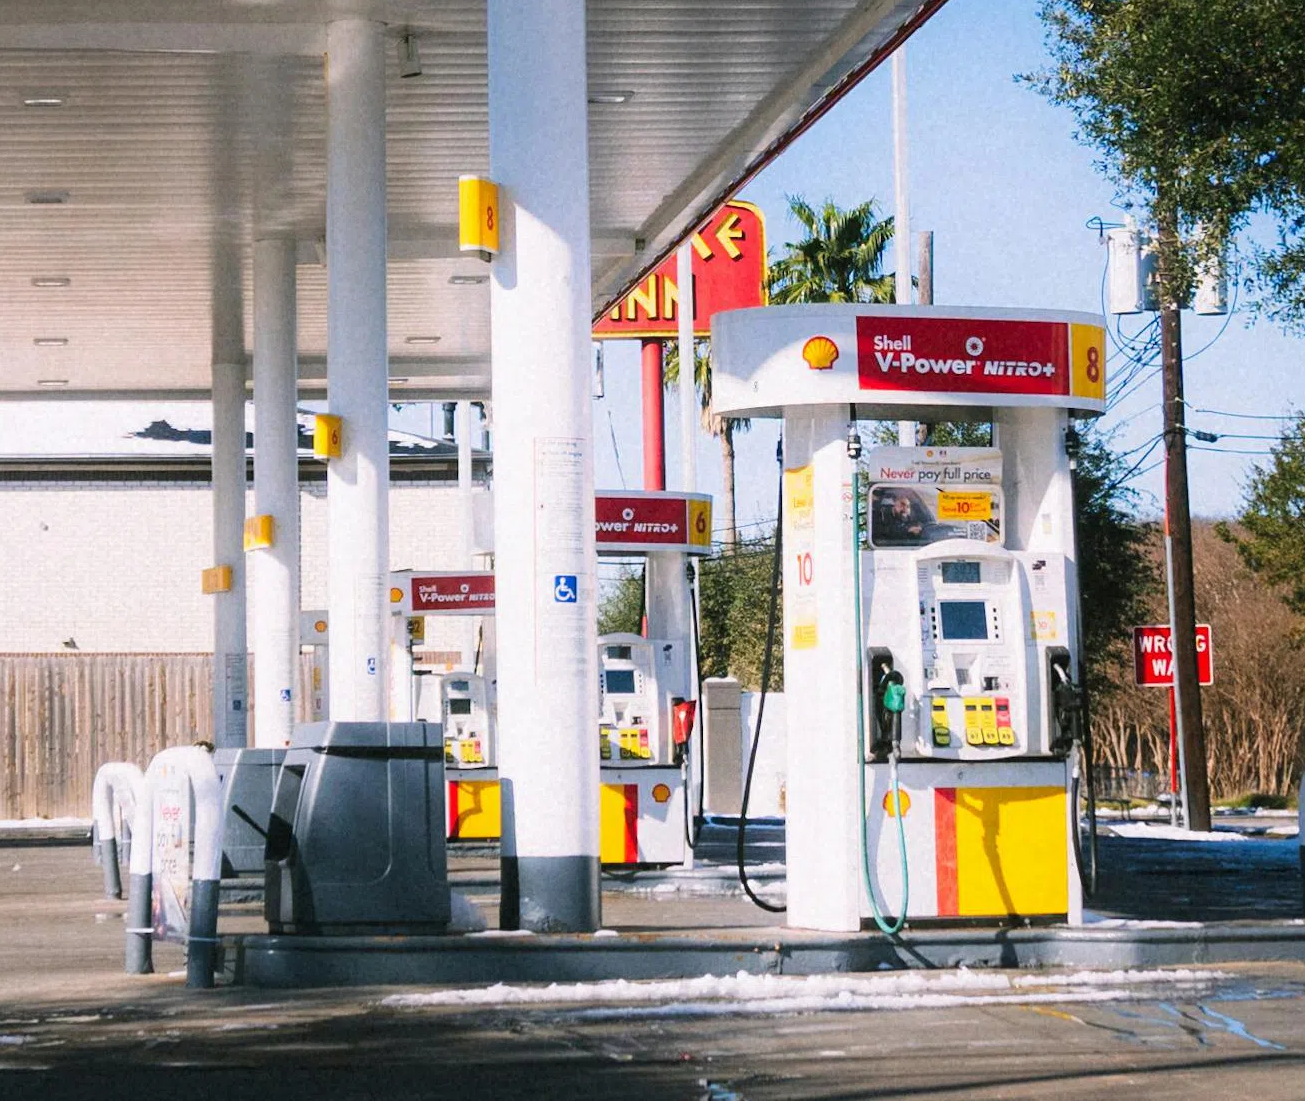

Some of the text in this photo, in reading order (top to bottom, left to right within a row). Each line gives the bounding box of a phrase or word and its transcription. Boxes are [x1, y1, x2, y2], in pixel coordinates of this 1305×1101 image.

[486, 206, 494, 231] 8
[873, 334, 912, 351] Shell
[874, 351, 976, 375] V-Power
[1086, 346, 1099, 383] 8
[331, 429, 338, 445] 6
[880, 467, 991, 483] Never pay full price
[594, 521, 629, 533] ower
[695, 512, 707, 534] 6
[796, 552, 813, 585] 10
[419, 592, 465, 603] V-Power
